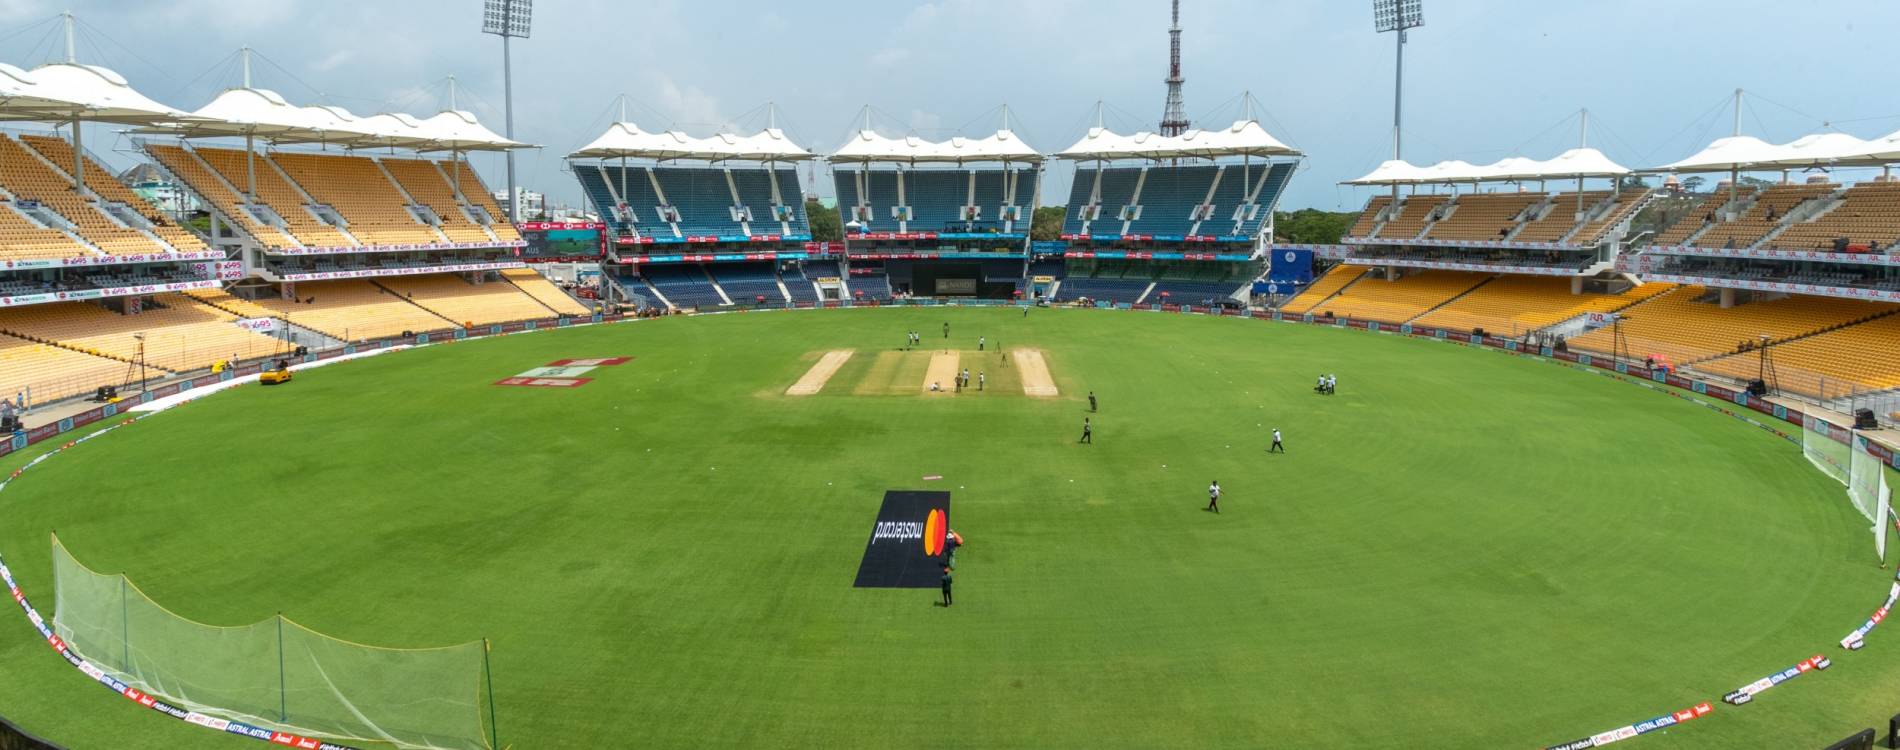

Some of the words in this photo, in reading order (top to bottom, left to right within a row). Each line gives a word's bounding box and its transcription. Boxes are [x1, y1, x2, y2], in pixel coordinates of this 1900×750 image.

[872, 521, 924, 544] mastercard
[227, 723, 250, 735] ASTRAL
[249, 727, 272, 740] ASTRAL
[1635, 721, 1656, 733] ASTRAL
